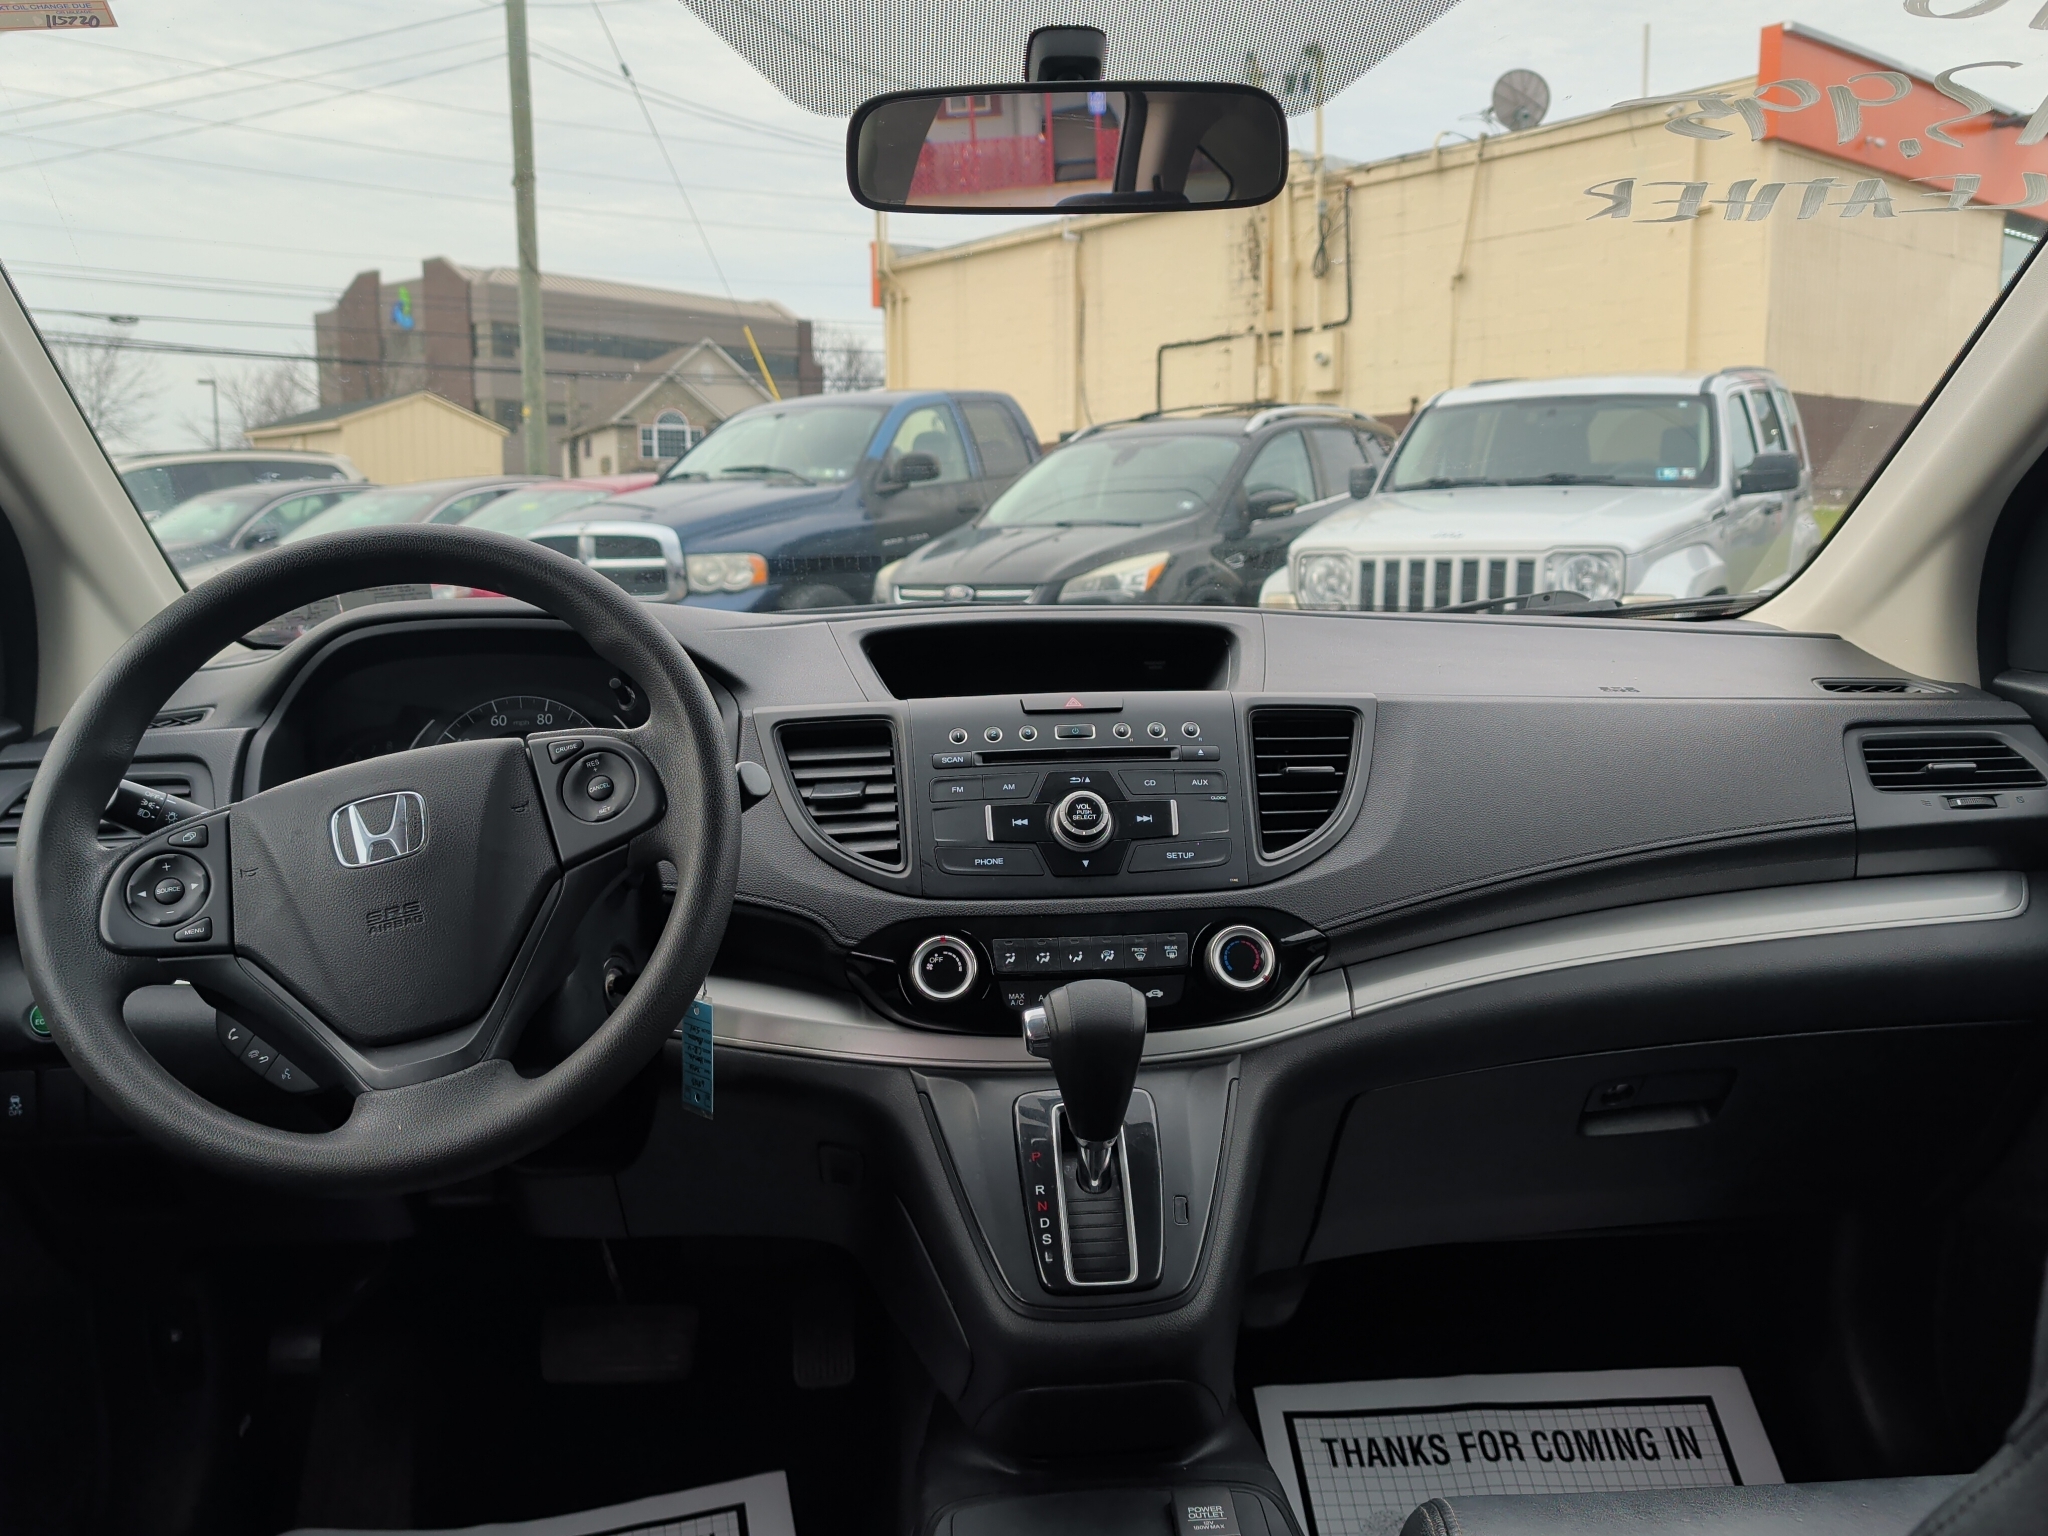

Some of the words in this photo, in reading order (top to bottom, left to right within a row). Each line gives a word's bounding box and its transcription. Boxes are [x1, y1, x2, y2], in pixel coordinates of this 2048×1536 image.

[46, 14, 100, 28] 115720
[490, 714, 507, 727] 60
[536, 714, 553, 726] 80
[555, 743, 578, 754] CRUISE
[586, 759, 600, 768] RES
[589, 782, 611, 793] CANCEL
[144, 790, 160, 799] OFF
[1166, 851, 1195, 860] SETUP
[974, 857, 1004, 866] PHONE
[156, 886, 181, 894] SOURCE
[184, 927, 204, 936] MENU
[1032, 1152, 1041, 1161] P
[1035, 1185, 1045, 1195] R
[1038, 1201, 1047, 1211] N
[1040, 1218, 1050, 1228] D
[1042, 1234, 1052, 1245] S
[1045, 1252, 1053, 1262] L
[1320, 1432, 1452, 1468] THANKS
[1458, 1428, 1526, 1464] FOR
[1532, 1426, 1660, 1464] COMING
[1662, 1425, 1703, 1460] IN
